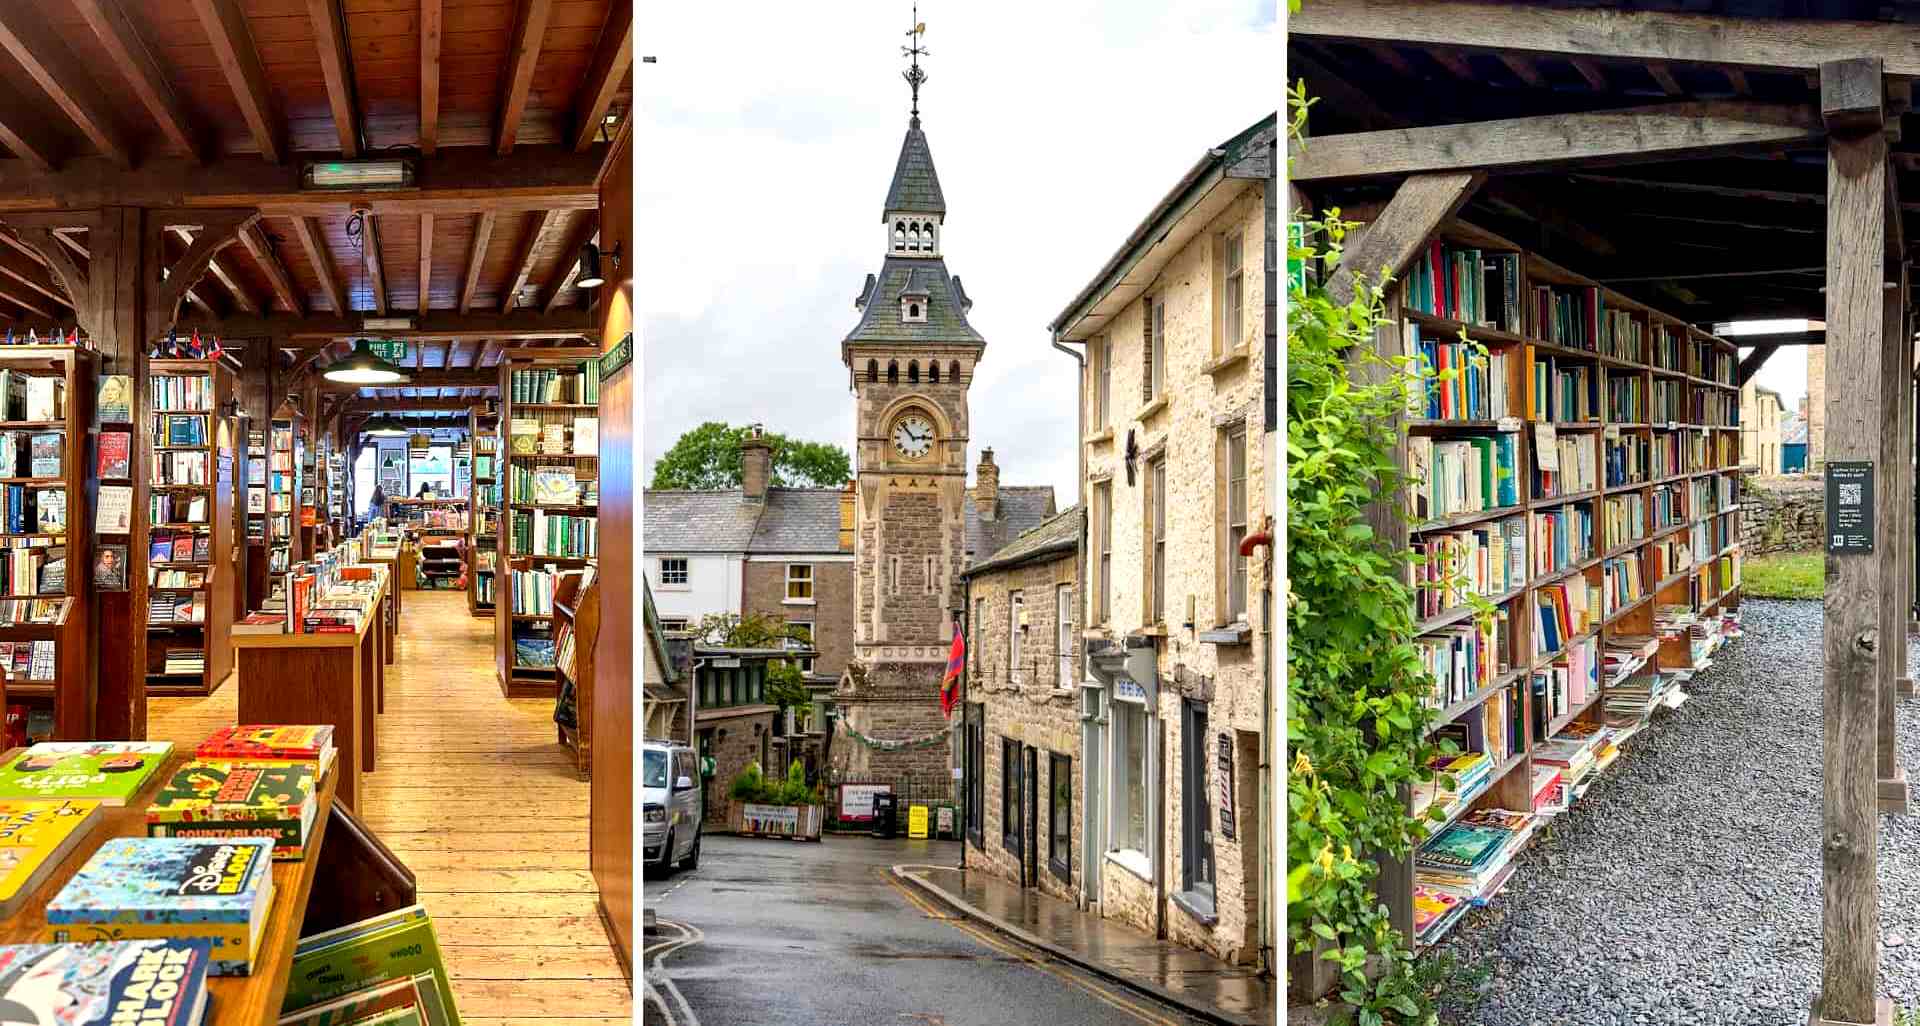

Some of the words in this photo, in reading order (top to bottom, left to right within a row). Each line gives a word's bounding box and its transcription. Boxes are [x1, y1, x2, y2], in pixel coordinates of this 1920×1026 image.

[369, 343, 390, 351] FIRE
[175, 827, 284, 839] COUNTABLOCK
[216, 845, 257, 894] BLOCK
